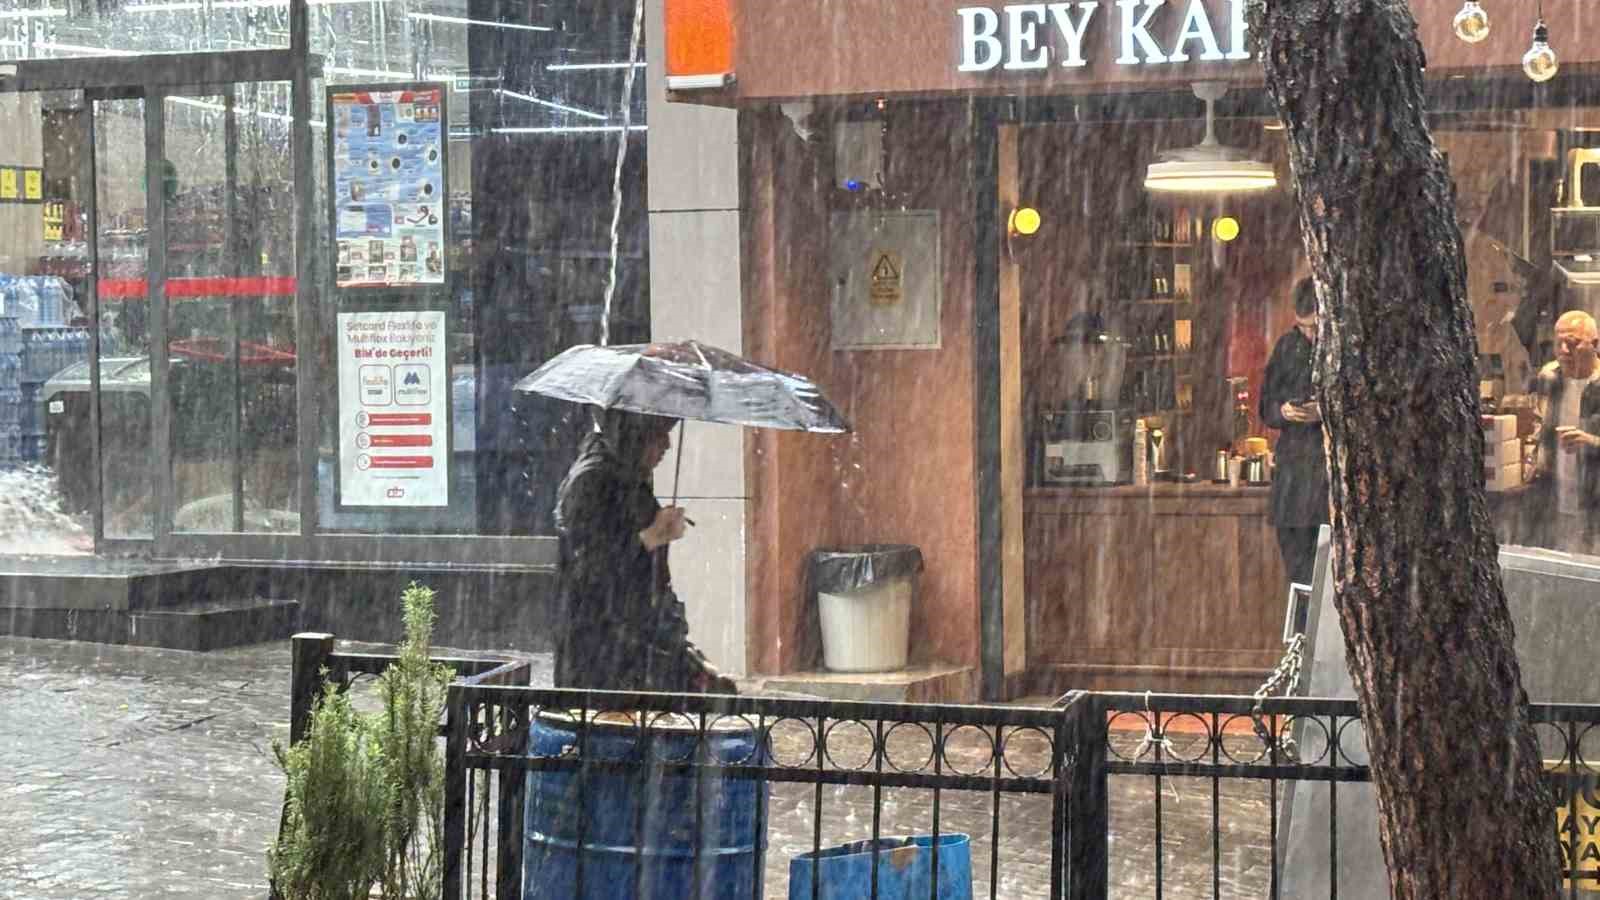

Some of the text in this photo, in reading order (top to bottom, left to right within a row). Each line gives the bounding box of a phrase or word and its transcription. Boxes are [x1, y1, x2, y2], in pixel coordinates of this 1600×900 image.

[957, 2, 1098, 71] BEY
[1560, 814, 1600, 834] AY
[1560, 840, 1600, 861] YA
